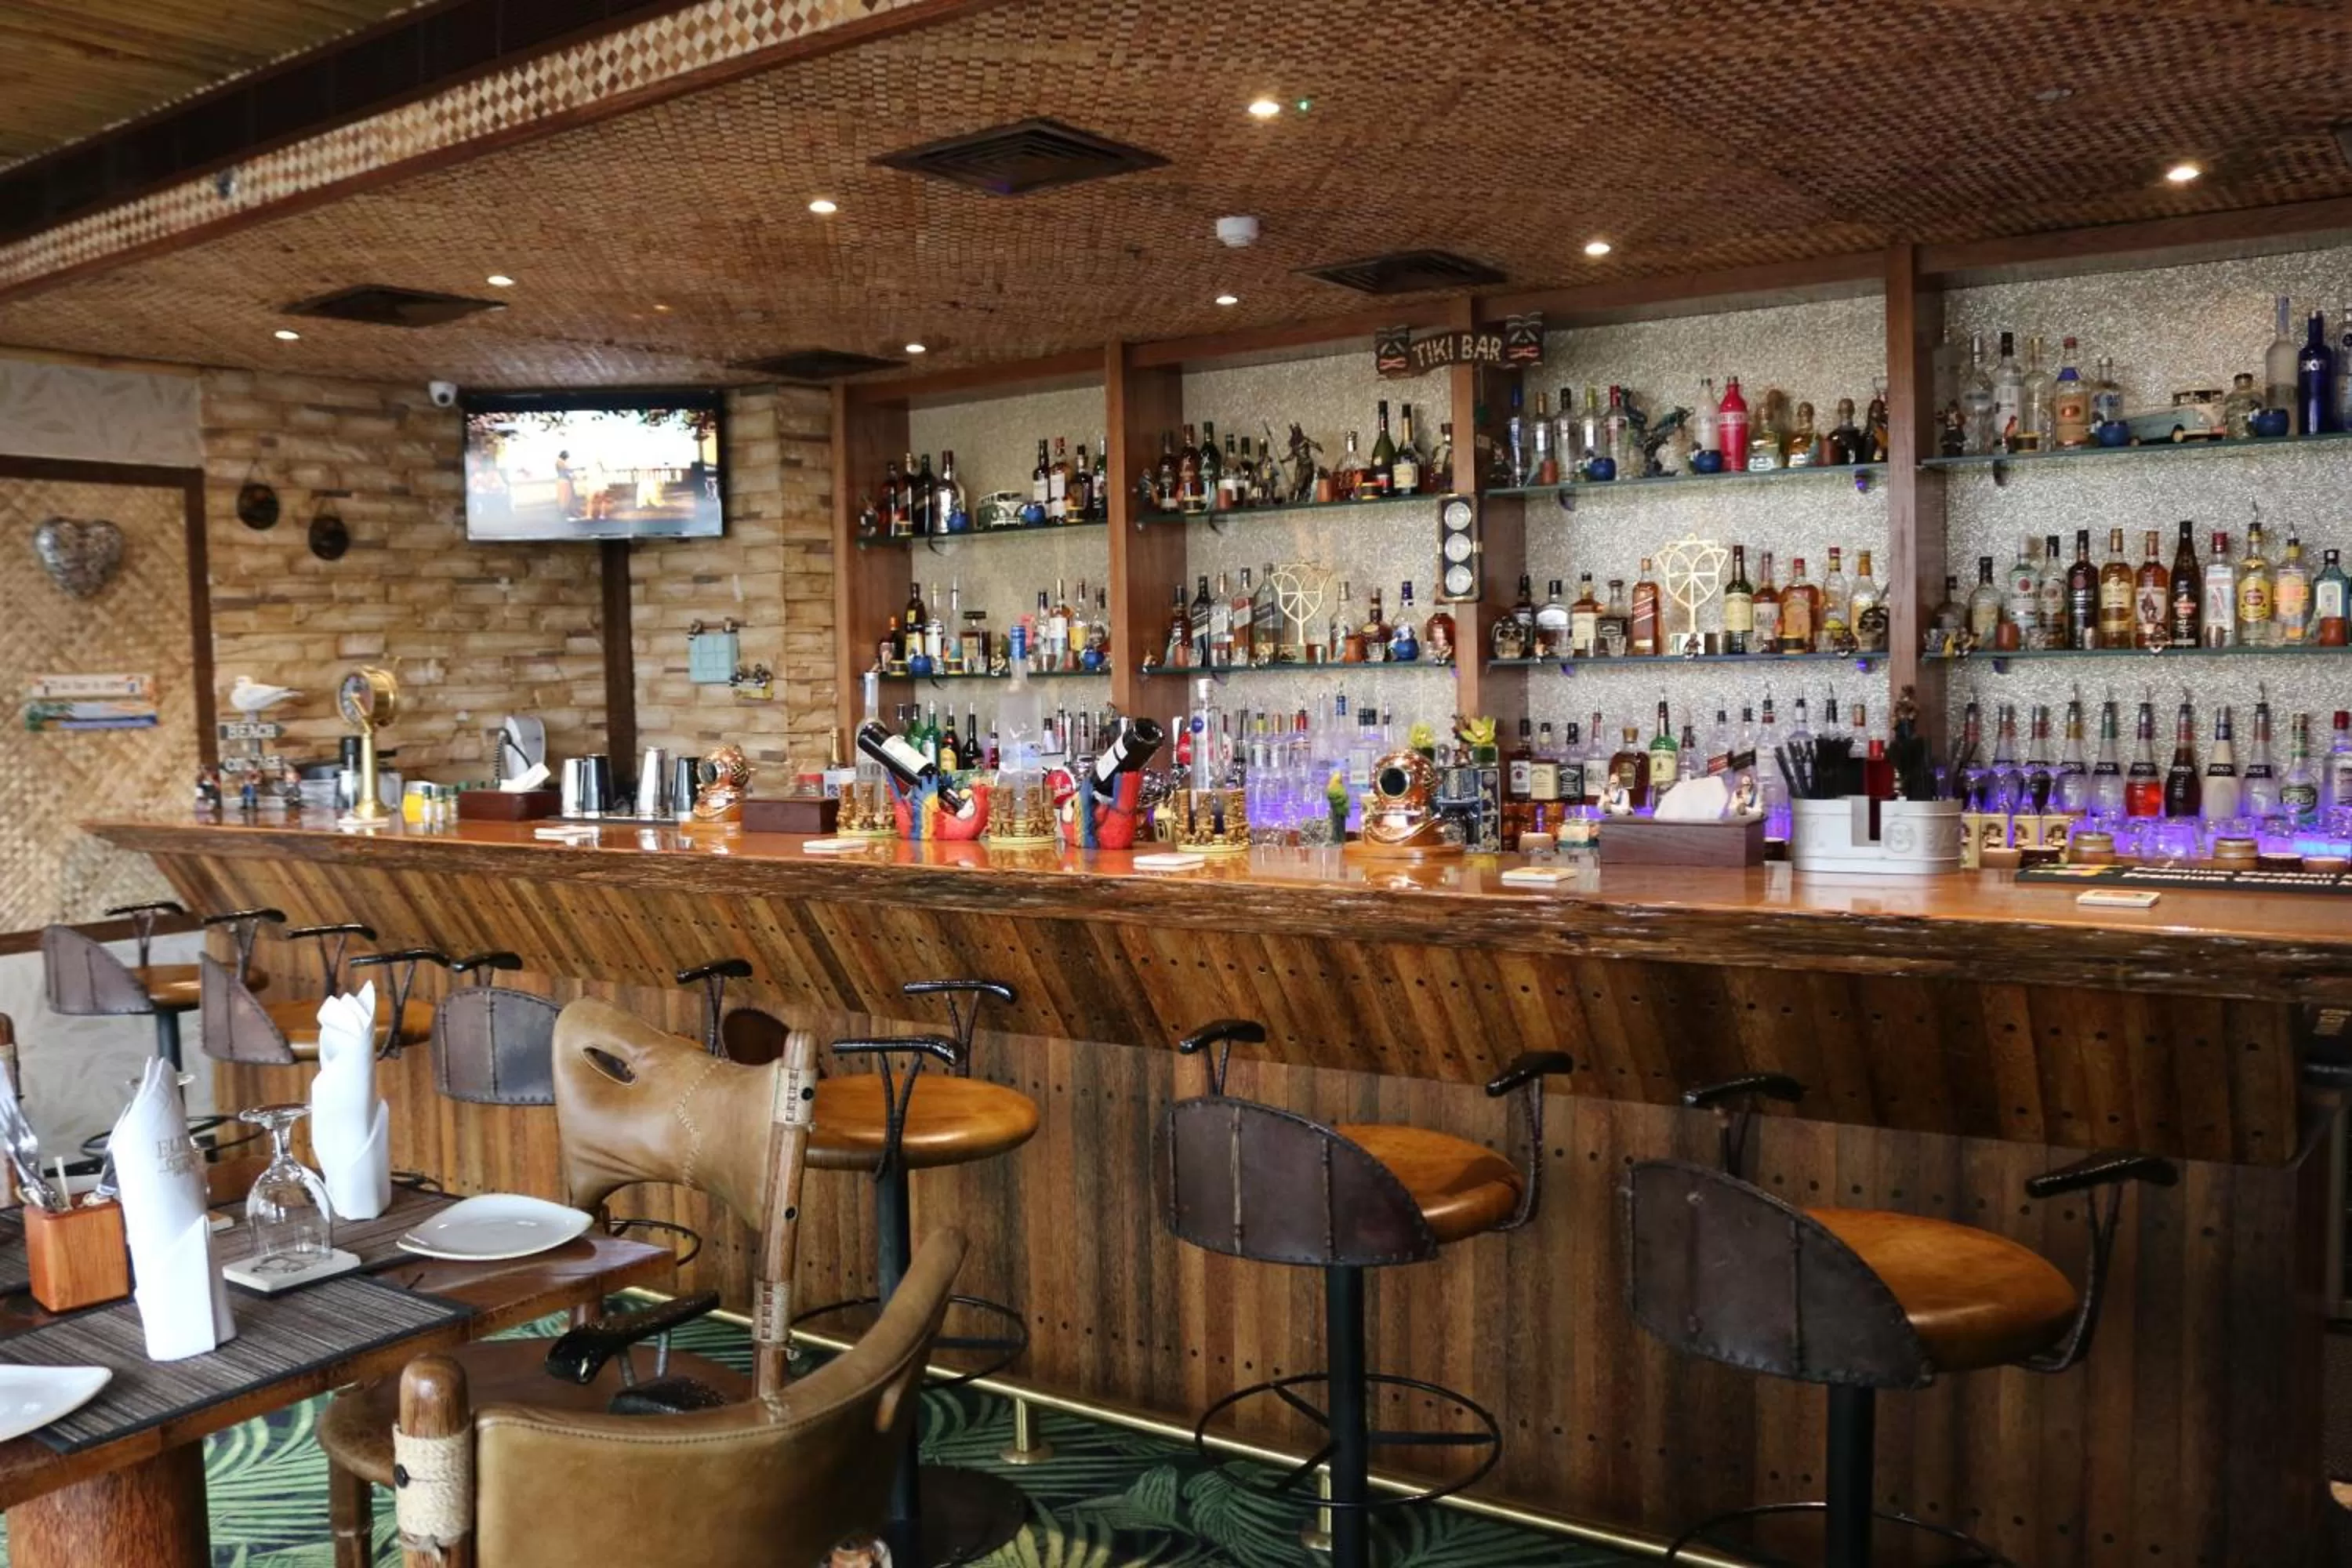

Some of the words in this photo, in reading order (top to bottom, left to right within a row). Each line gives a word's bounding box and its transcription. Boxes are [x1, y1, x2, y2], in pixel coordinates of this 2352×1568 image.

[1412, 335, 1453, 367] TIKI
[1461, 334, 1502, 362] BAR
[227, 724, 275, 739] BEACH
